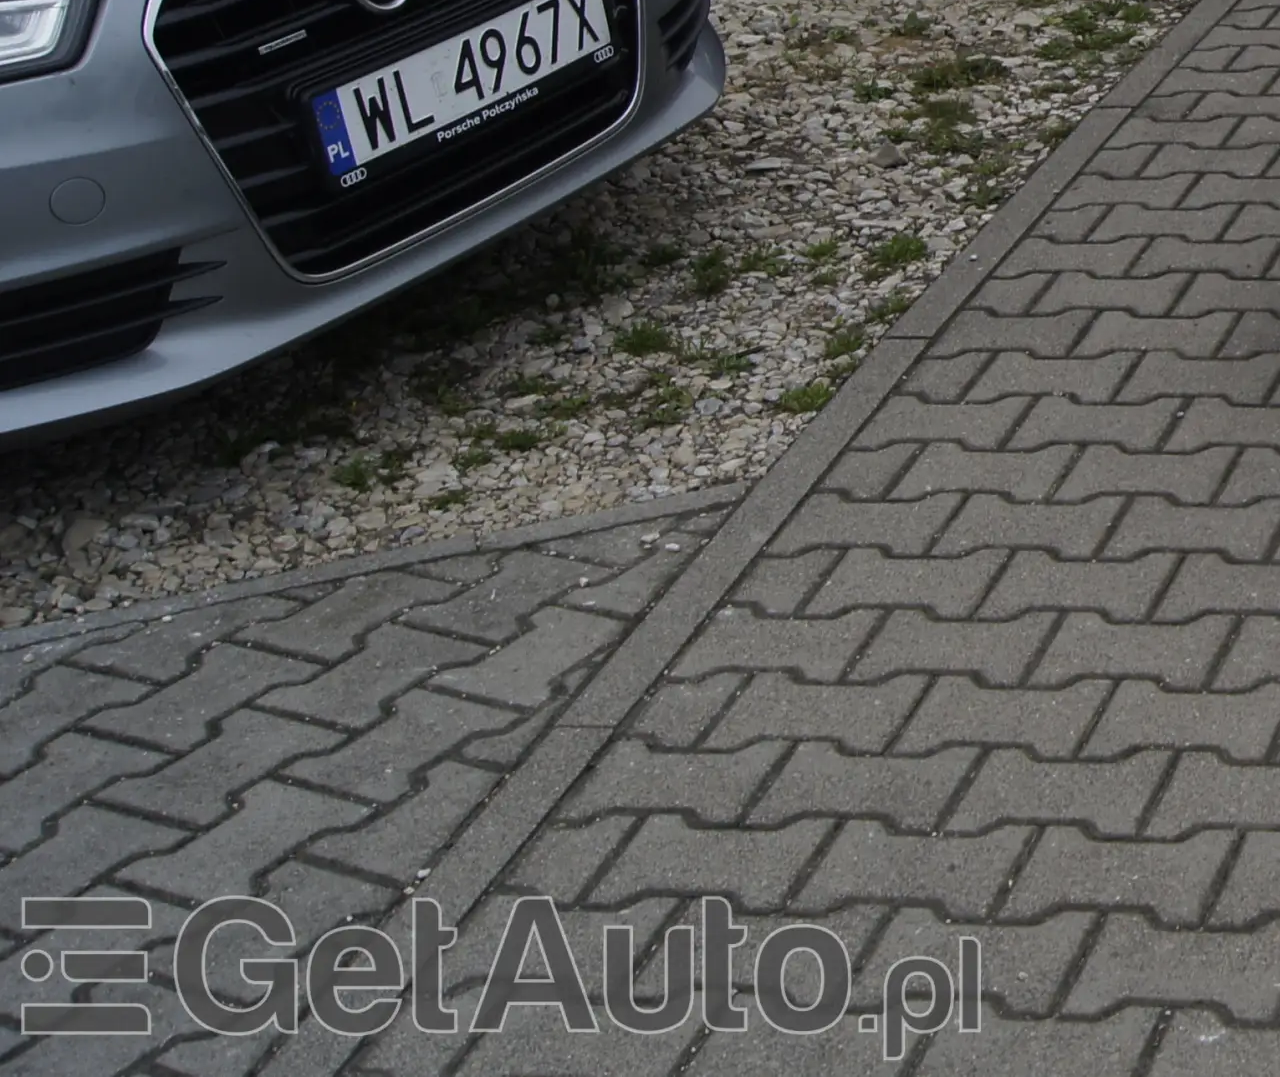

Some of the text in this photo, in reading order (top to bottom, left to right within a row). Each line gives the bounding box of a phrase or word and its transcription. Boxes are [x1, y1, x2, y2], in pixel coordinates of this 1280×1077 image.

[327, 142, 350, 164] PL
[353, 69, 436, 152] WL
[436, 85, 540, 143] Porsche Połczyńska
